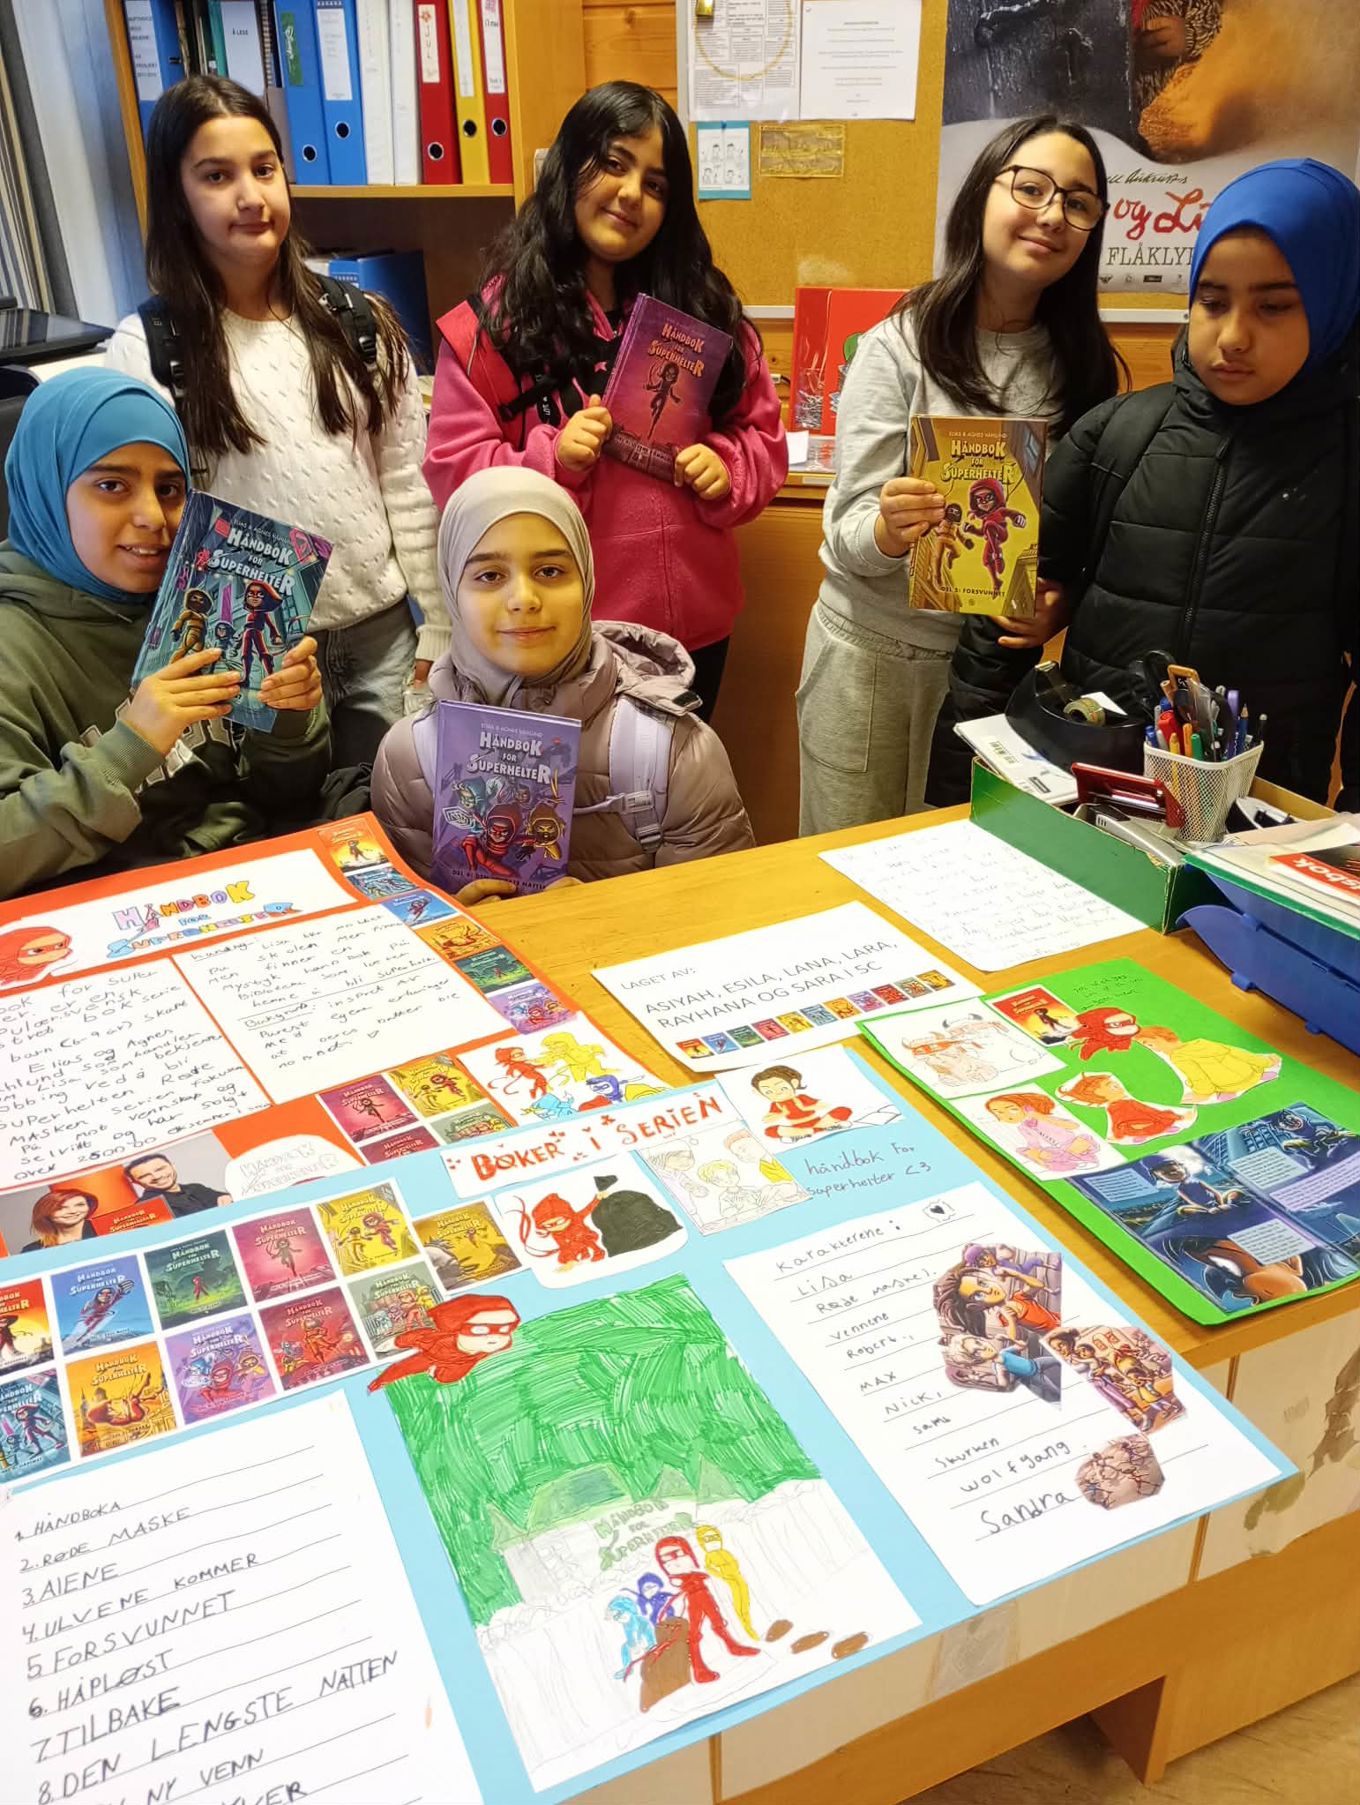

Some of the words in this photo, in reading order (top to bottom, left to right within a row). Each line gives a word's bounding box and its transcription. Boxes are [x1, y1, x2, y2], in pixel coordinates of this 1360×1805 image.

[662, 322, 704, 353] HÅNDBOK
[648, 339, 704, 377] SUPERHELTER
[952, 439, 1006, 457] HÅNDBOK
[941, 464, 1015, 484] SUPERHELTER
[227, 528, 293, 566] HÅNDBOK
[248, 554, 264, 566] FOR
[207, 549, 295, 596] SUPERHELTER
[479, 732, 543, 757] HÅNDBOK
[503, 753, 517, 762] FOR
[467, 754, 551, 784] SUPERHELTER
[112, 880, 255, 932] HÅNDBOK
[621, 972, 667, 991] LAGET
[645, 989, 722, 1016] ASIYAH,
[722, 972, 783, 1001] ESILA,
[784, 956, 843, 985] LANA,
[842, 940, 898, 963] LARA,
[658, 997, 756, 1029] RAYHANA
[757, 983, 790, 1003] OG
[791, 972, 843, 993] SARA
[470, 1139, 564, 1181] BØKER
[616, 1095, 723, 1145] SERIEN
[805, 1149, 884, 1176] håndbok
[806, 1173, 895, 1200] superhelter
[776, 1227, 884, 1274] Karakterene
[798, 1273, 852, 1296] Lisa
[34, 1500, 122, 1536] HÅNDBOKA
[980, 1488, 1075, 1535] Sandra
[43, 1542, 91, 1568] RØDE
[108, 1507, 192, 1546] MASKE
[44, 1589, 150, 1640] ULVENE
[53, 1589, 236, 1674] FORSVUNNET
[56, 1649, 174, 1712] HÅPLØST
[56, 1687, 181, 1756] TILBAKE
[63, 1753, 122, 1800] DEN
[150, 1687, 294, 1763] LENGSTE
[318, 1650, 398, 1698] NATTEN
[199, 1747, 264, 1787] VENN
